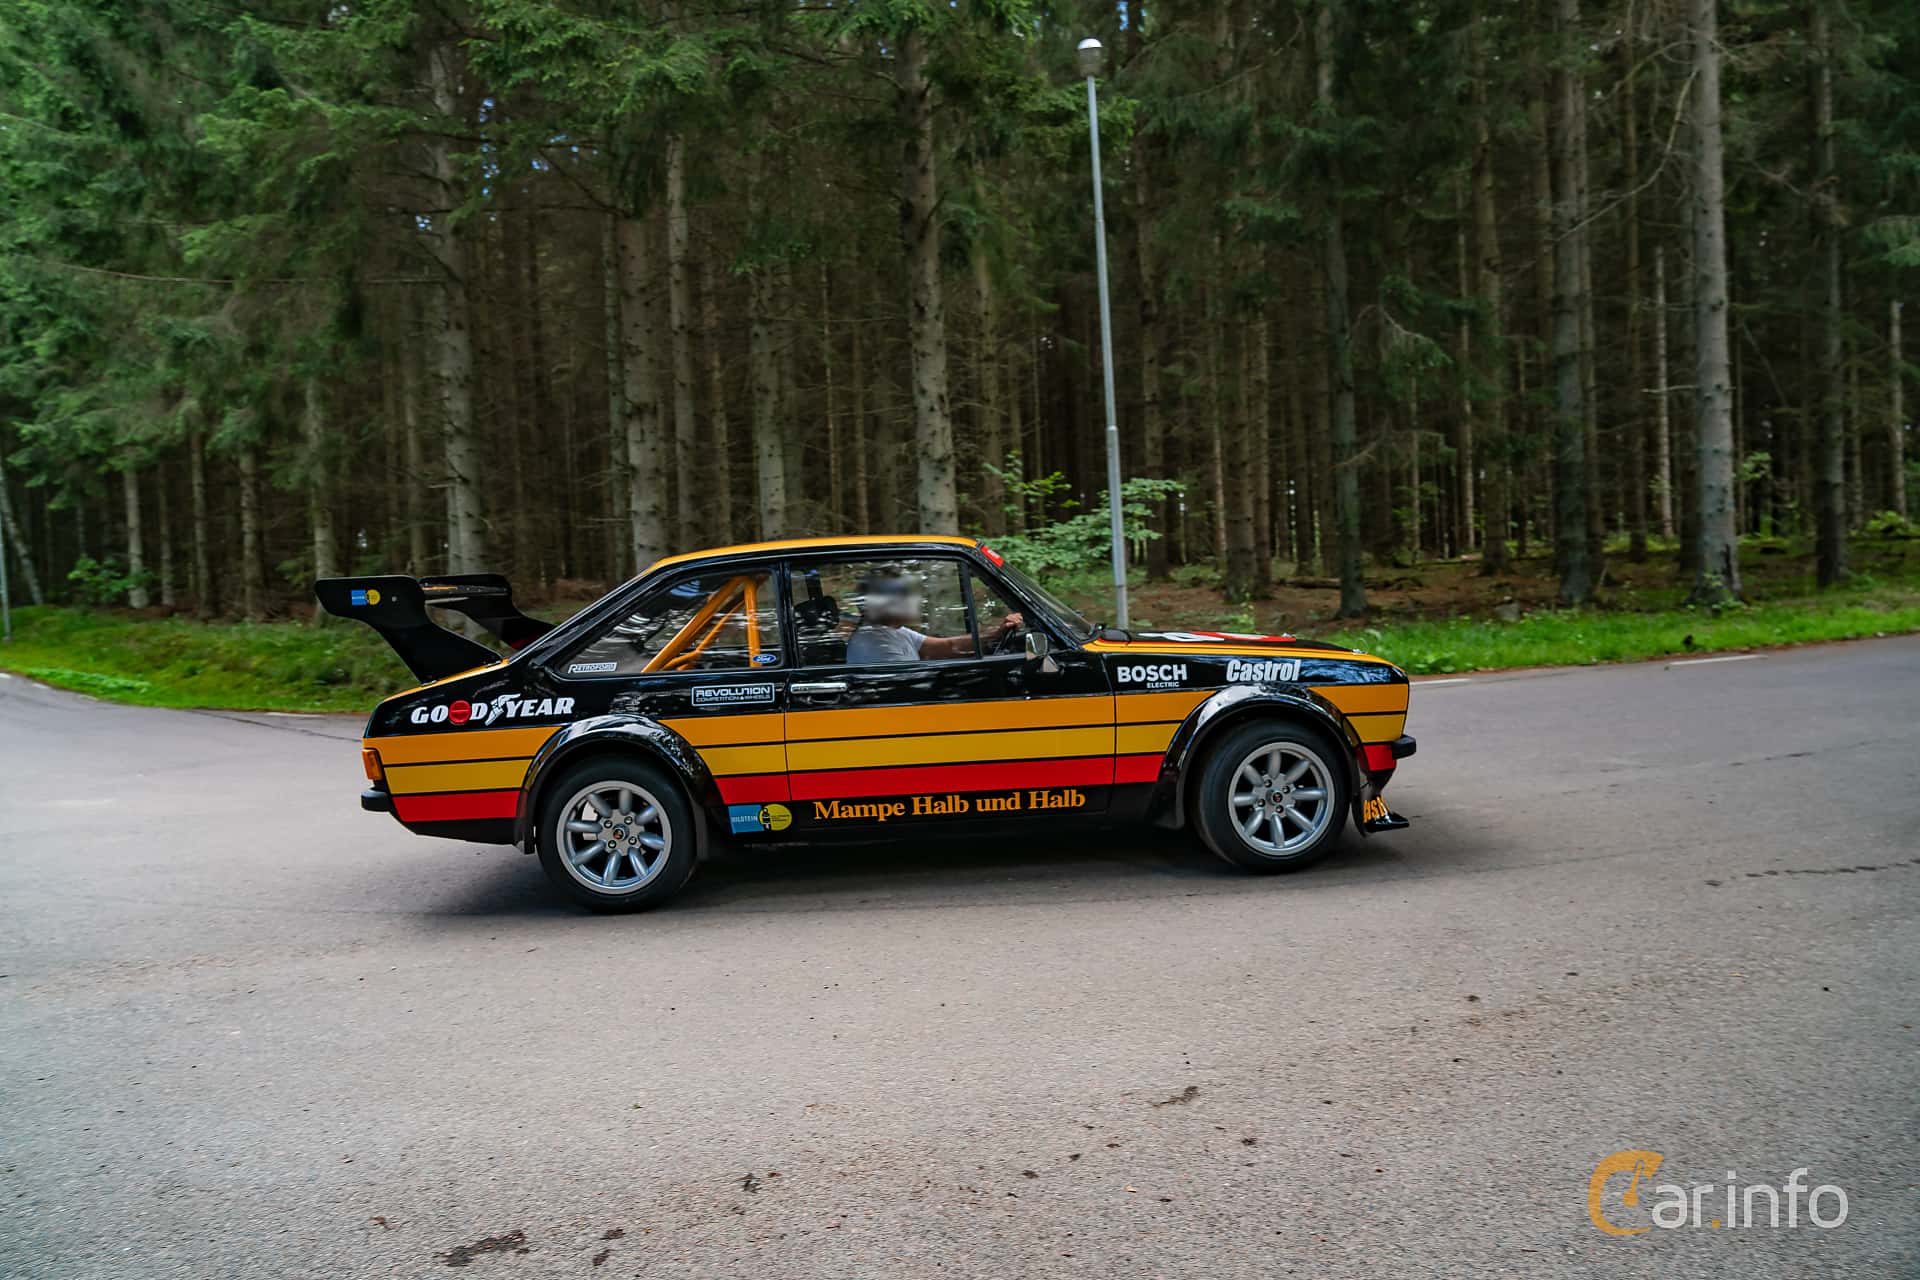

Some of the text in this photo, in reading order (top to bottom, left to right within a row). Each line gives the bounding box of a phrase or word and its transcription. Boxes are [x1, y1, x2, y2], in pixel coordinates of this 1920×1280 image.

[1116, 663, 1188, 683] BOSCH
[1226, 659, 1301, 682] Castrol
[696, 686, 770, 698] REVOLUTION
[813, 789, 1087, 821] Mampe Halb und Halb
